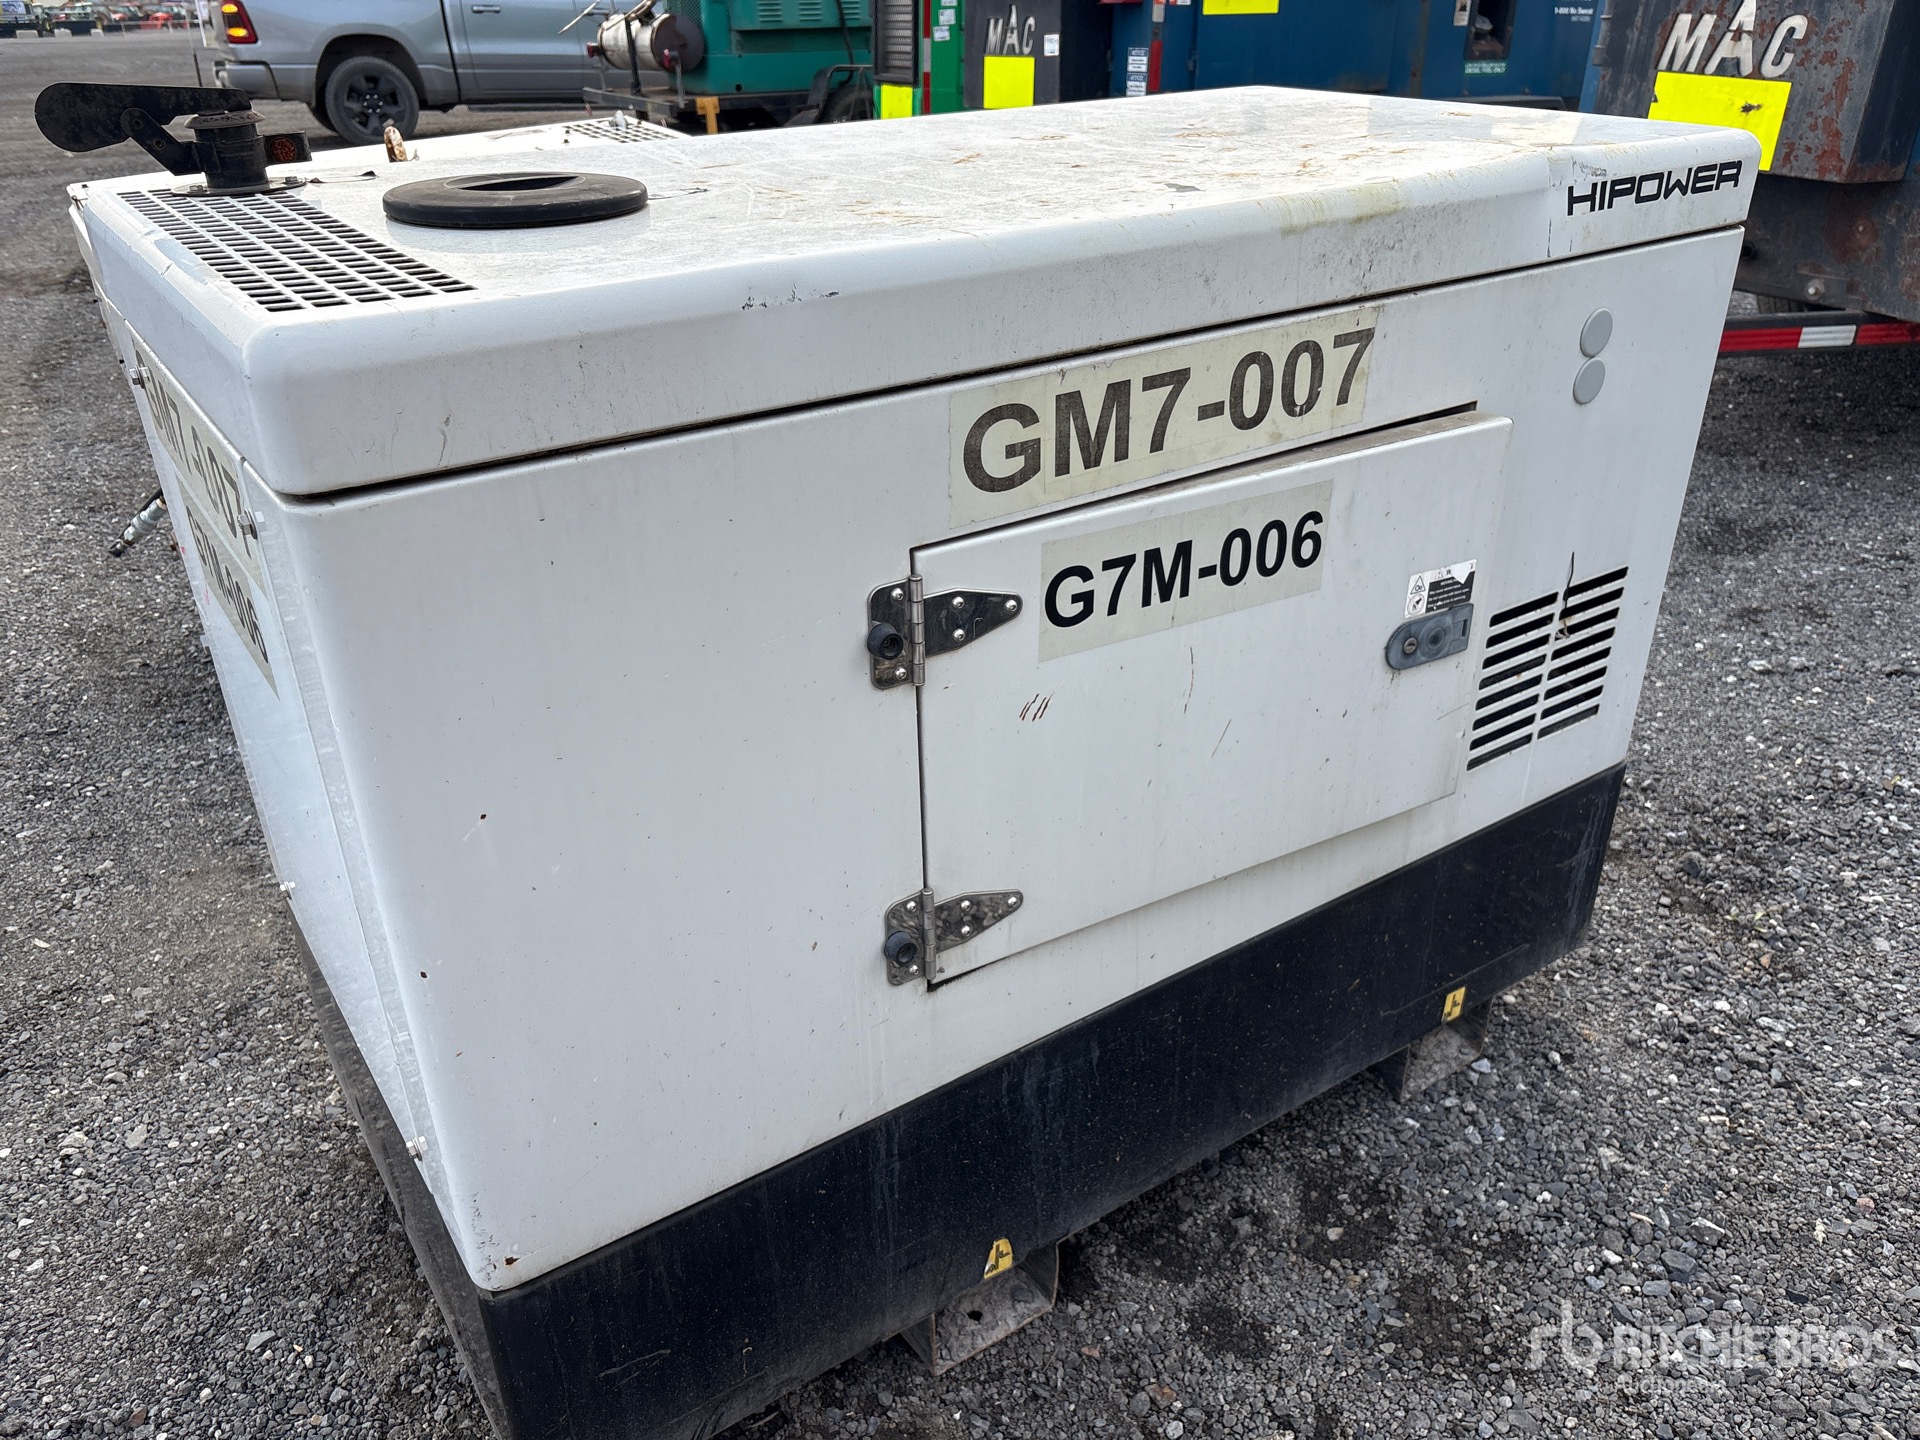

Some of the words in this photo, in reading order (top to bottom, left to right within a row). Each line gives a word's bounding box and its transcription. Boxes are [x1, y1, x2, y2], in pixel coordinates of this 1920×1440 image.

[987, 4, 1036, 55] MAC
[1657, 0, 1808, 78] MAC
[1566, 160, 1743, 216] HIPOWER
[962, 327, 1375, 493] GM7-007
[1044, 510, 1324, 628] G7M-006
